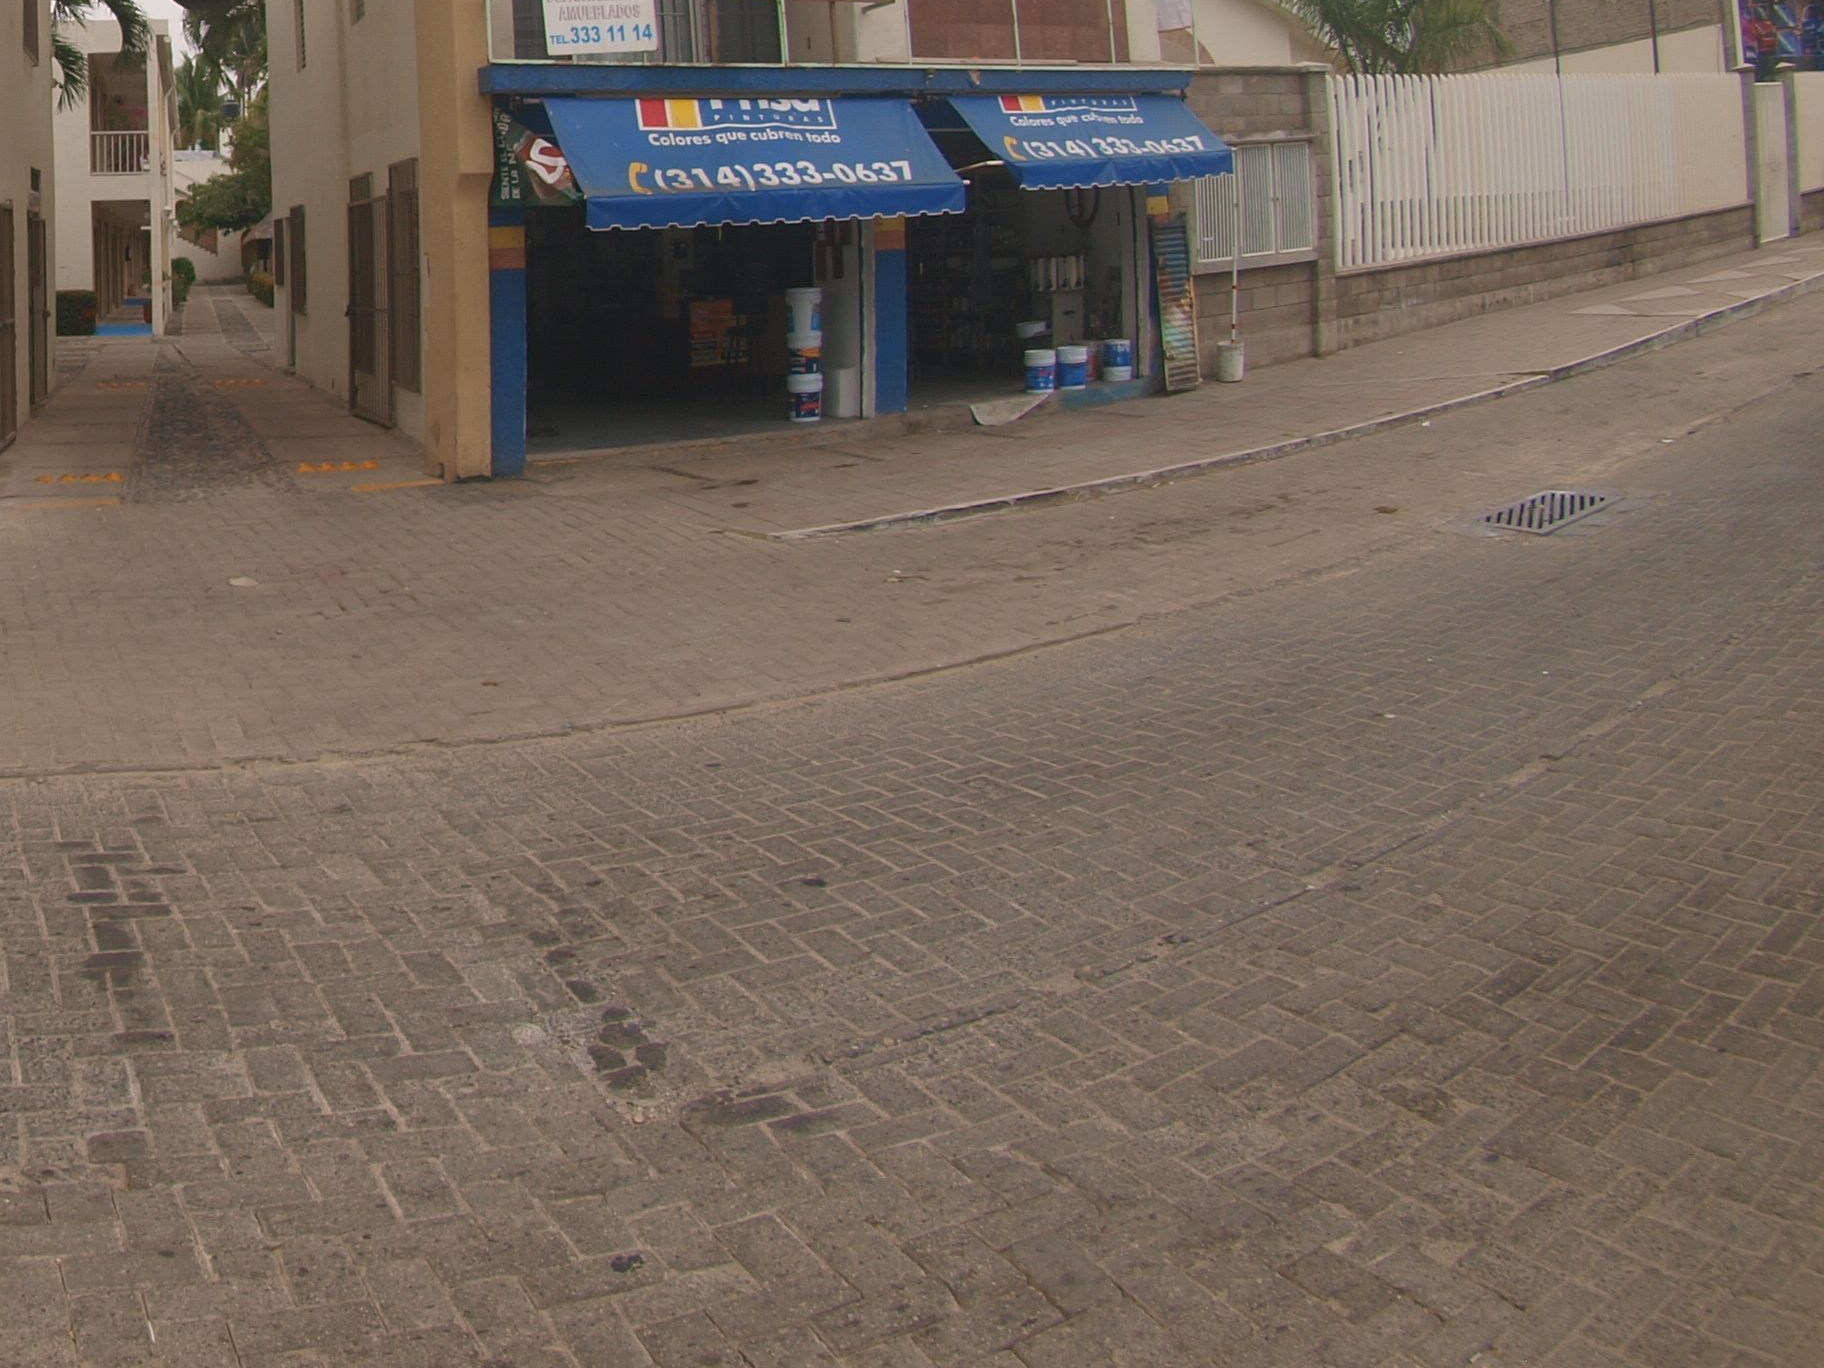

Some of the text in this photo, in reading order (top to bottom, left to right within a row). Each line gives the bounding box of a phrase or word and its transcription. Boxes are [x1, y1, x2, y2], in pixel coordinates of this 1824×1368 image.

[559, 4, 640, 21] AMUEBLADOS
[607, 24, 625, 42] 11
[632, 23, 653, 41] 14
[1009, 112, 1143, 127] Colores que cubren todo
[648, 128, 841, 146] Colores que cubren todo
[500, 165, 510, 200] SIENTE
